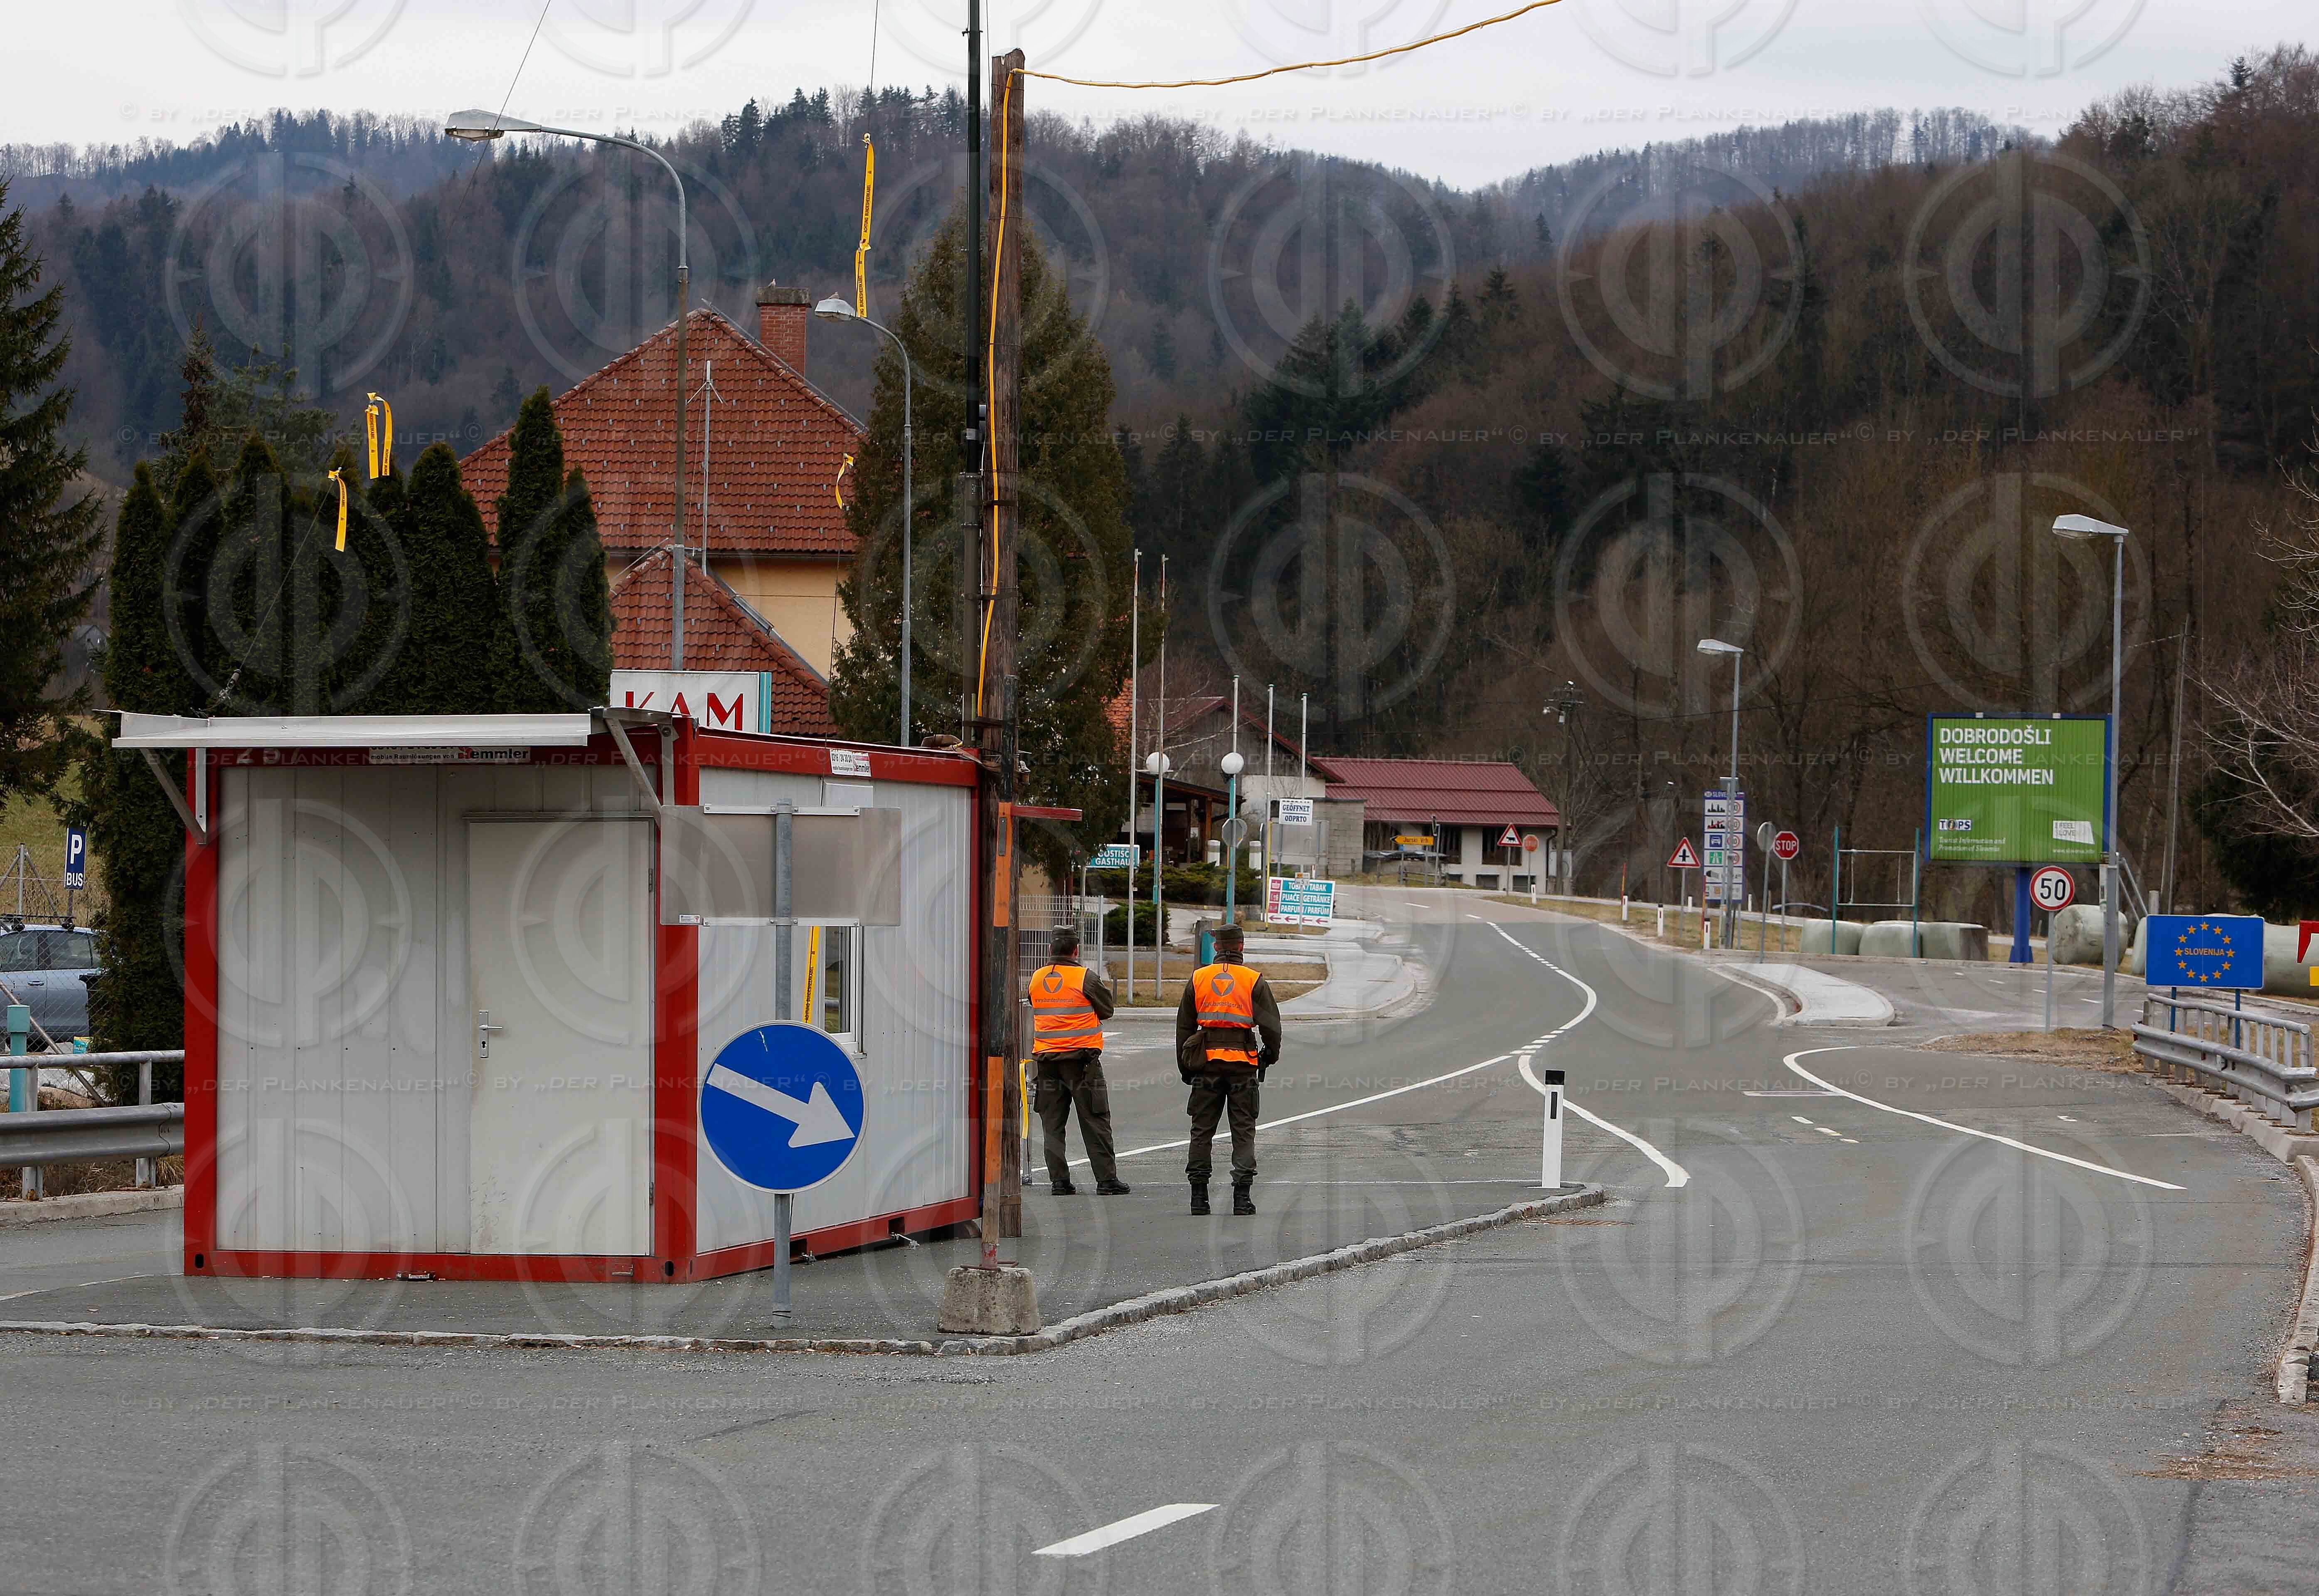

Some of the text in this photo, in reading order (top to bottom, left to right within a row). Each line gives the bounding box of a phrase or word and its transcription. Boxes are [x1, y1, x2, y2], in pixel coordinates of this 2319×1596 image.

[1940, 725, 2051, 745] DOBRODOŠLI
[1939, 749, 2023, 764] WELCOME
[1939, 768, 2054, 785] WILLKOMMEN
[1283, 803, 1310, 812] GEÖFFNET
[70, 834, 82, 864] P
[1775, 841, 1797, 851] STOP
[66, 872, 83, 887] BUS
[2040, 877, 2066, 900] 50
[1303, 894, 1331, 903] GETRÄNKE
[1308, 906, 1329, 915] PARFÜM
[2184, 947, 2225, 956] SLOVENIJA
